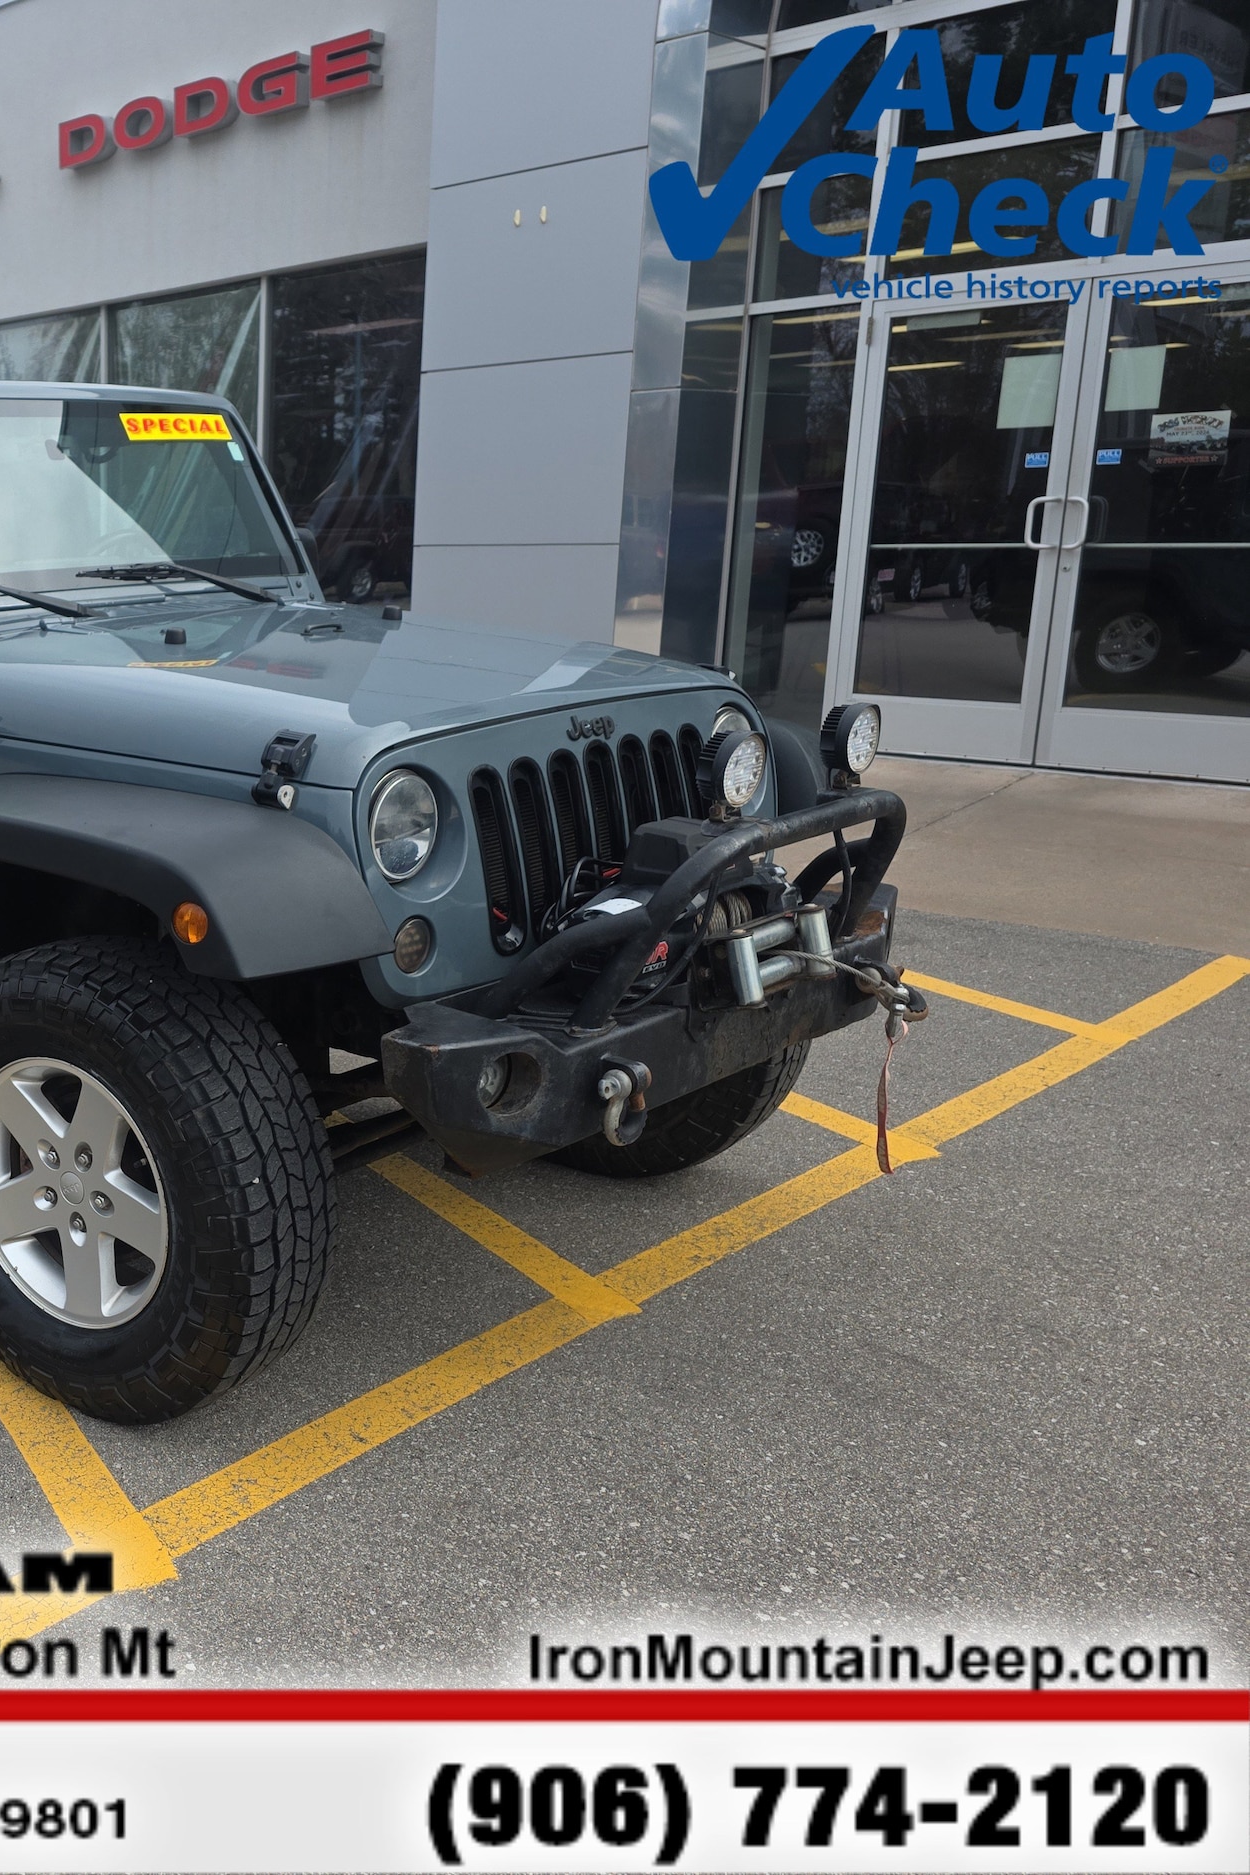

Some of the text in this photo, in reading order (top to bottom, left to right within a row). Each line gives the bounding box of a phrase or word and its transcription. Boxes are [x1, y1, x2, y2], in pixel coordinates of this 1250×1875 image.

[58, 28, 385, 170] DODGE
[126, 418, 227, 434] SPECIAL
[566, 715, 616, 741] Jeep
